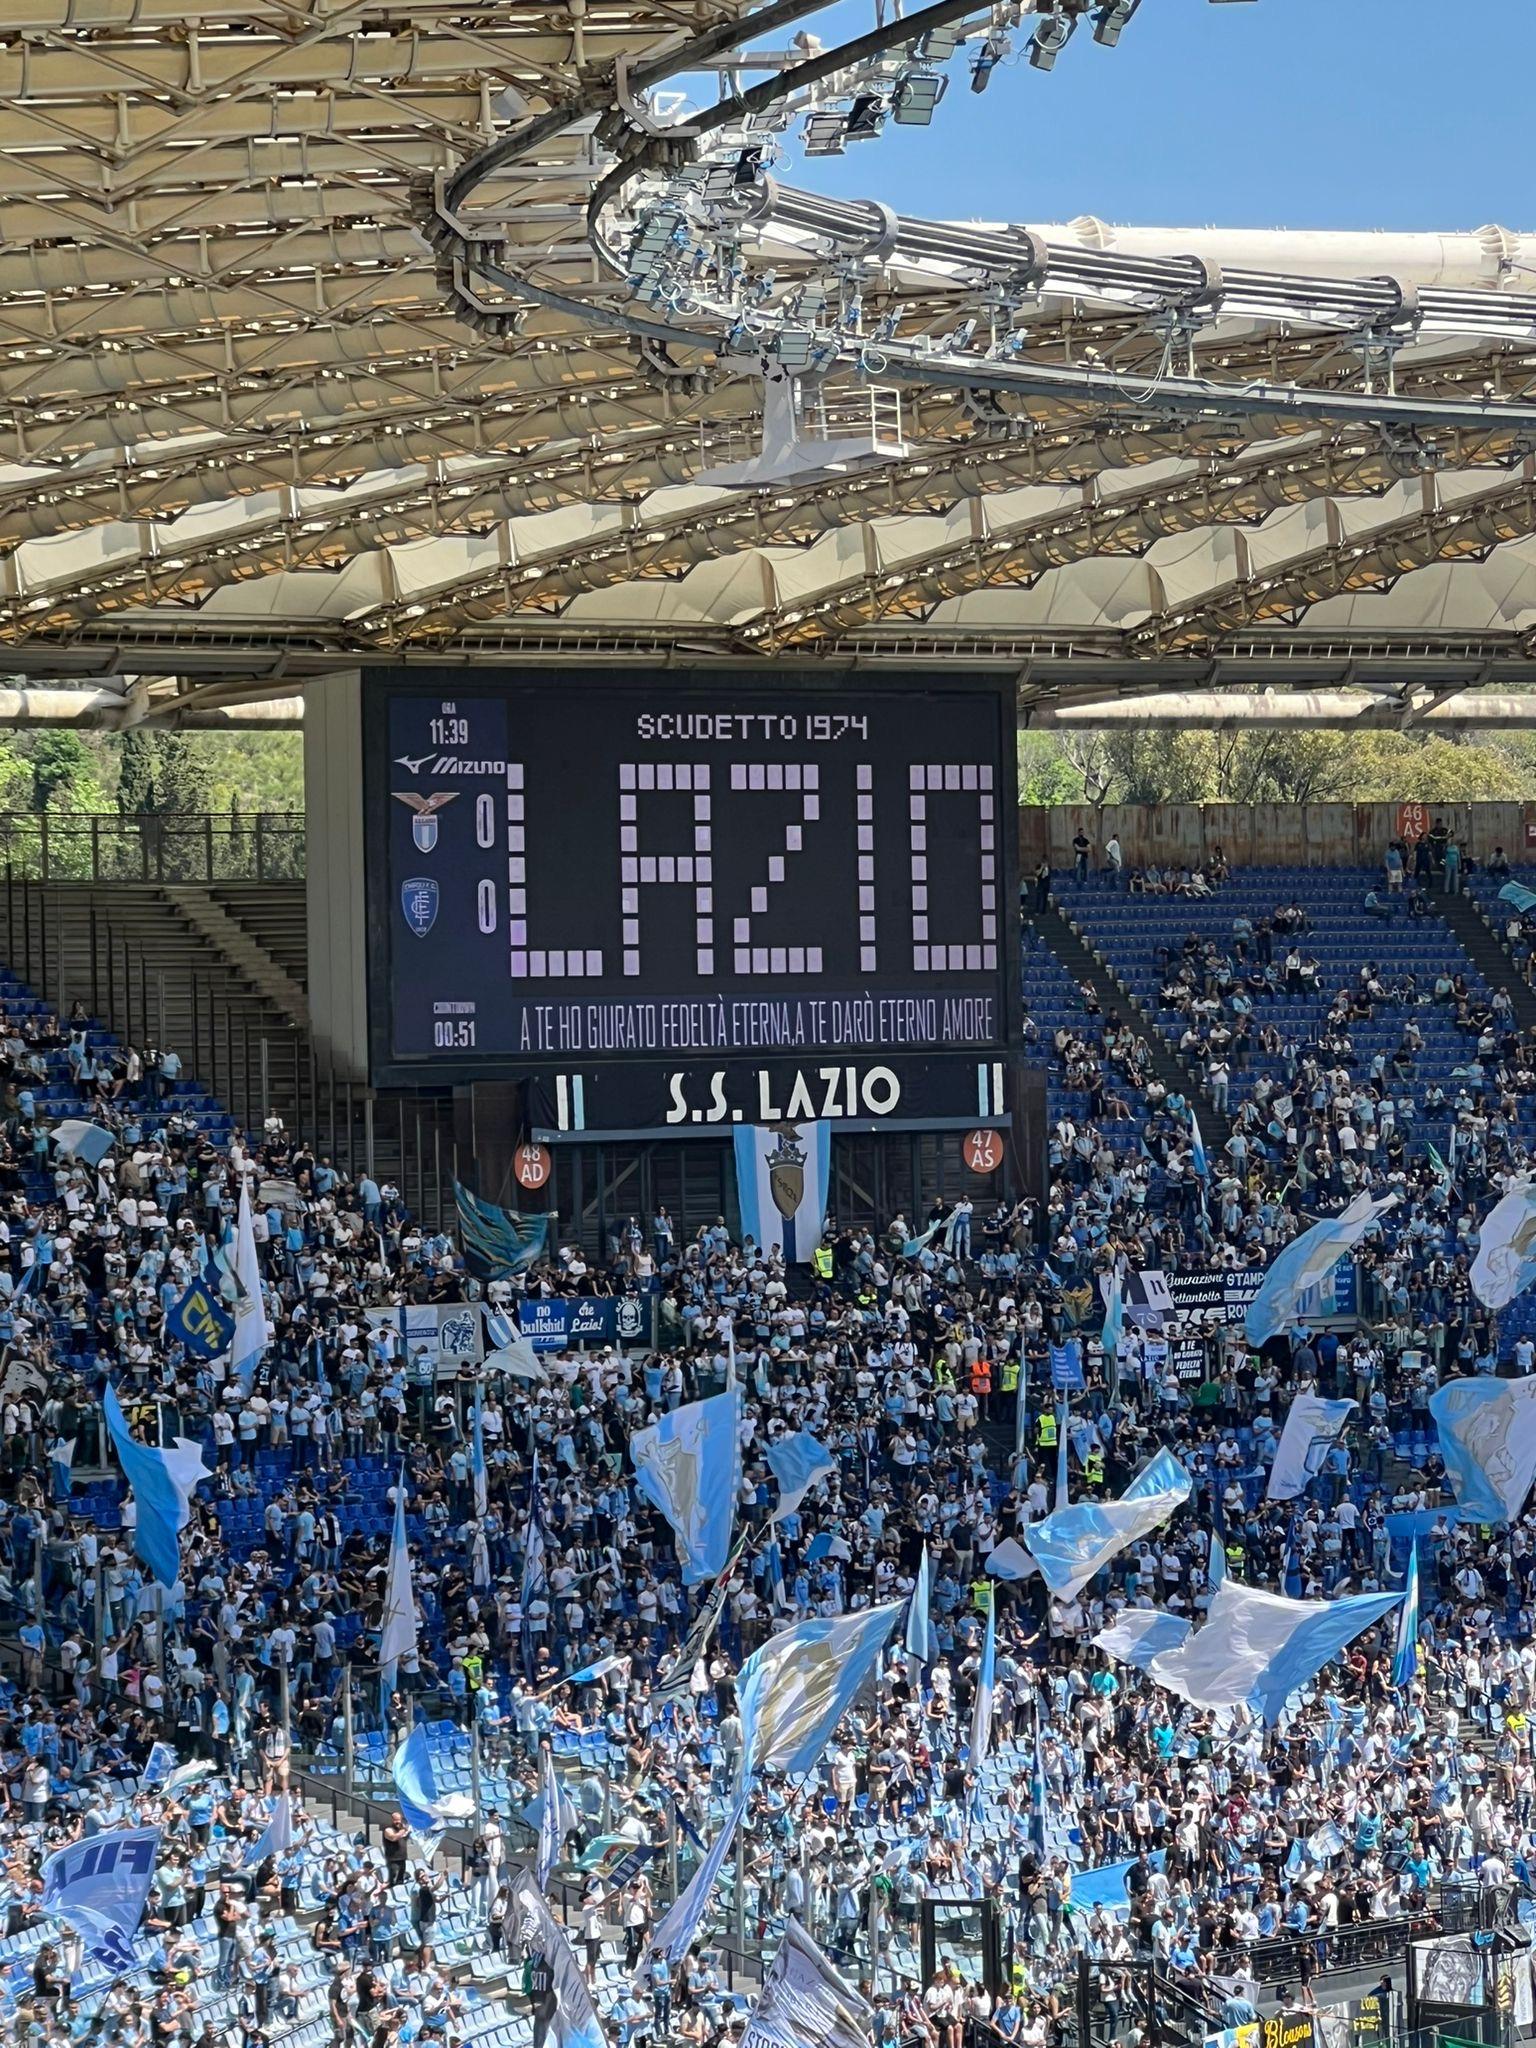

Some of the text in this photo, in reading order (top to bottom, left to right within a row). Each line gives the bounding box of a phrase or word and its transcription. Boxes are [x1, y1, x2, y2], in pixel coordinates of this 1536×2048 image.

[429, 718, 469, 744] 11:39
[637, 714, 868, 740] SCUDETTO 1974
[476, 793, 495, 849] 0
[1403, 805, 1423, 820] 46
[1403, 821, 1424, 838] AS
[507, 763, 997, 978] LAZIO
[477, 878, 497, 934] 0
[520, 1006, 531, 1051] A
[535, 1006, 554, 1050] TE
[559, 1005, 582, 1050] HO
[587, 1005, 657, 1049] GIURATO
[662, 993, 728, 1047] FEDELTÀ
[809, 1000, 827, 1044] TE
[832, 990, 874, 1045] DARÒ
[879, 998, 936, 1043] ETERNO
[942, 997, 994, 1041] AMORE
[434, 1021, 476, 1047] 00:51
[666, 1065, 901, 1124] S.S. LAZIO
[971, 1130, 993, 1148] 47
[522, 1145, 541, 1161] 48
[971, 1149, 995, 1168] AS
[520, 1163, 544, 1183] AD
[536, 1305, 551, 1317] no
